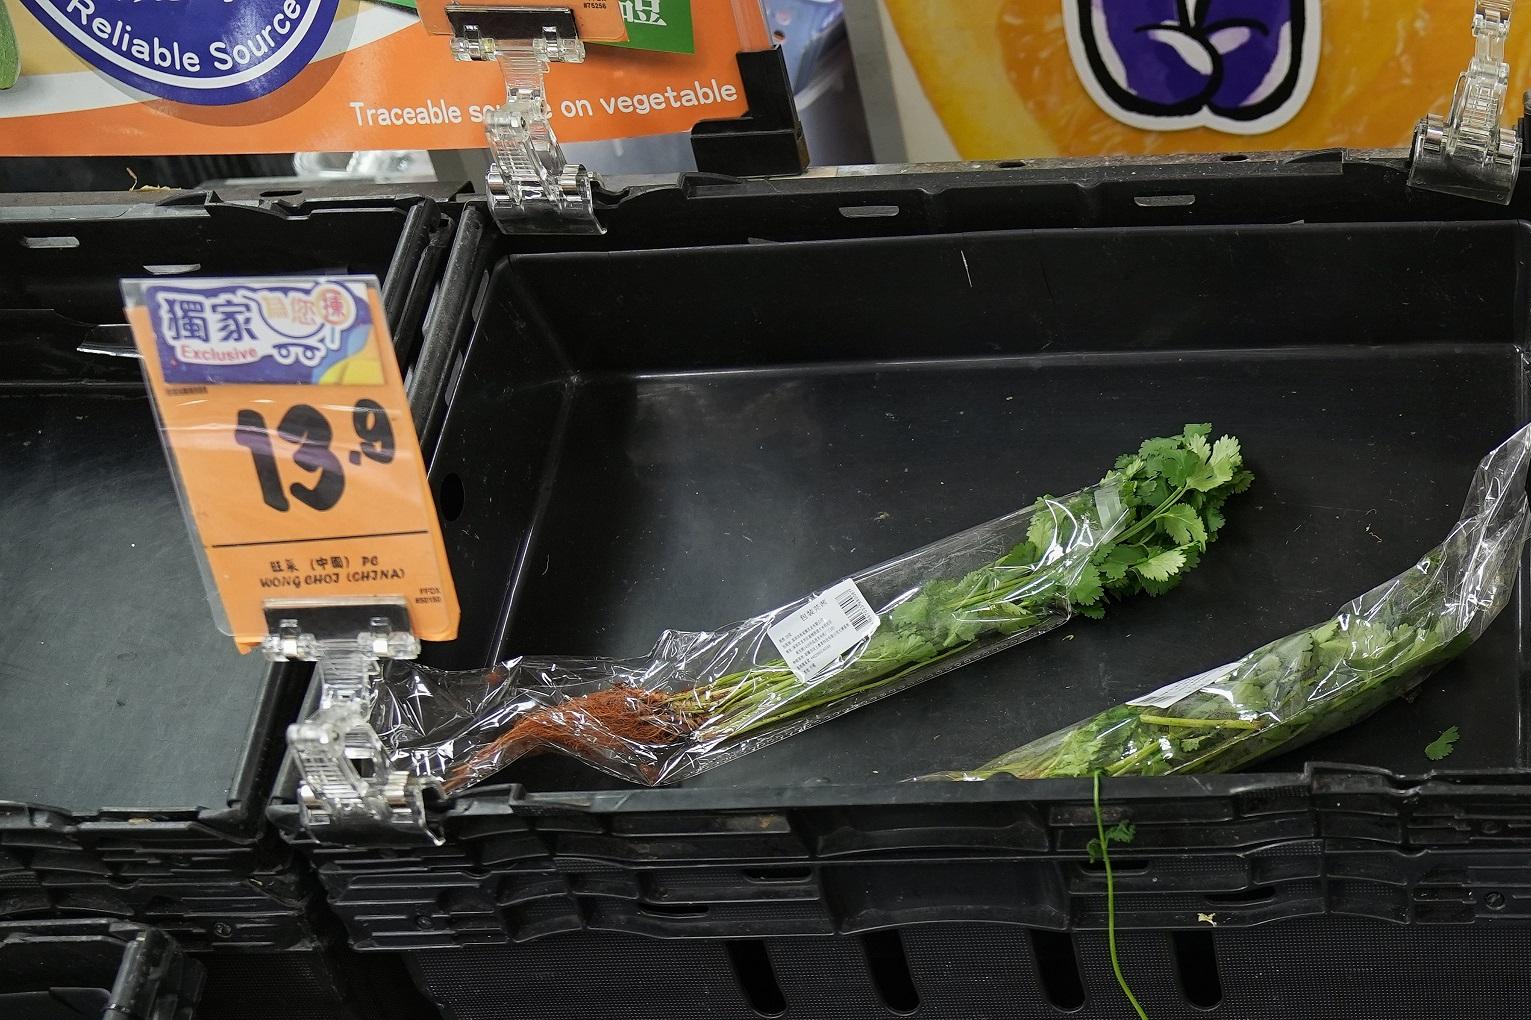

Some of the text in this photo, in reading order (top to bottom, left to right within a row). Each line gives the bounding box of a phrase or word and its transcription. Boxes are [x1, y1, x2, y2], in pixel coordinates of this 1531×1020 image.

[66, 0, 301, 72] Reliable Source
[350, 99, 462, 126] Traceable
[560, 97, 593, 118] on
[599, 79, 739, 116] vegetable
[164, 297, 259, 342] 獨家
[180, 345, 258, 361] Exclusive
[259, 575, 302, 588] WONG
[346, 568, 406, 583] (CHINA)
